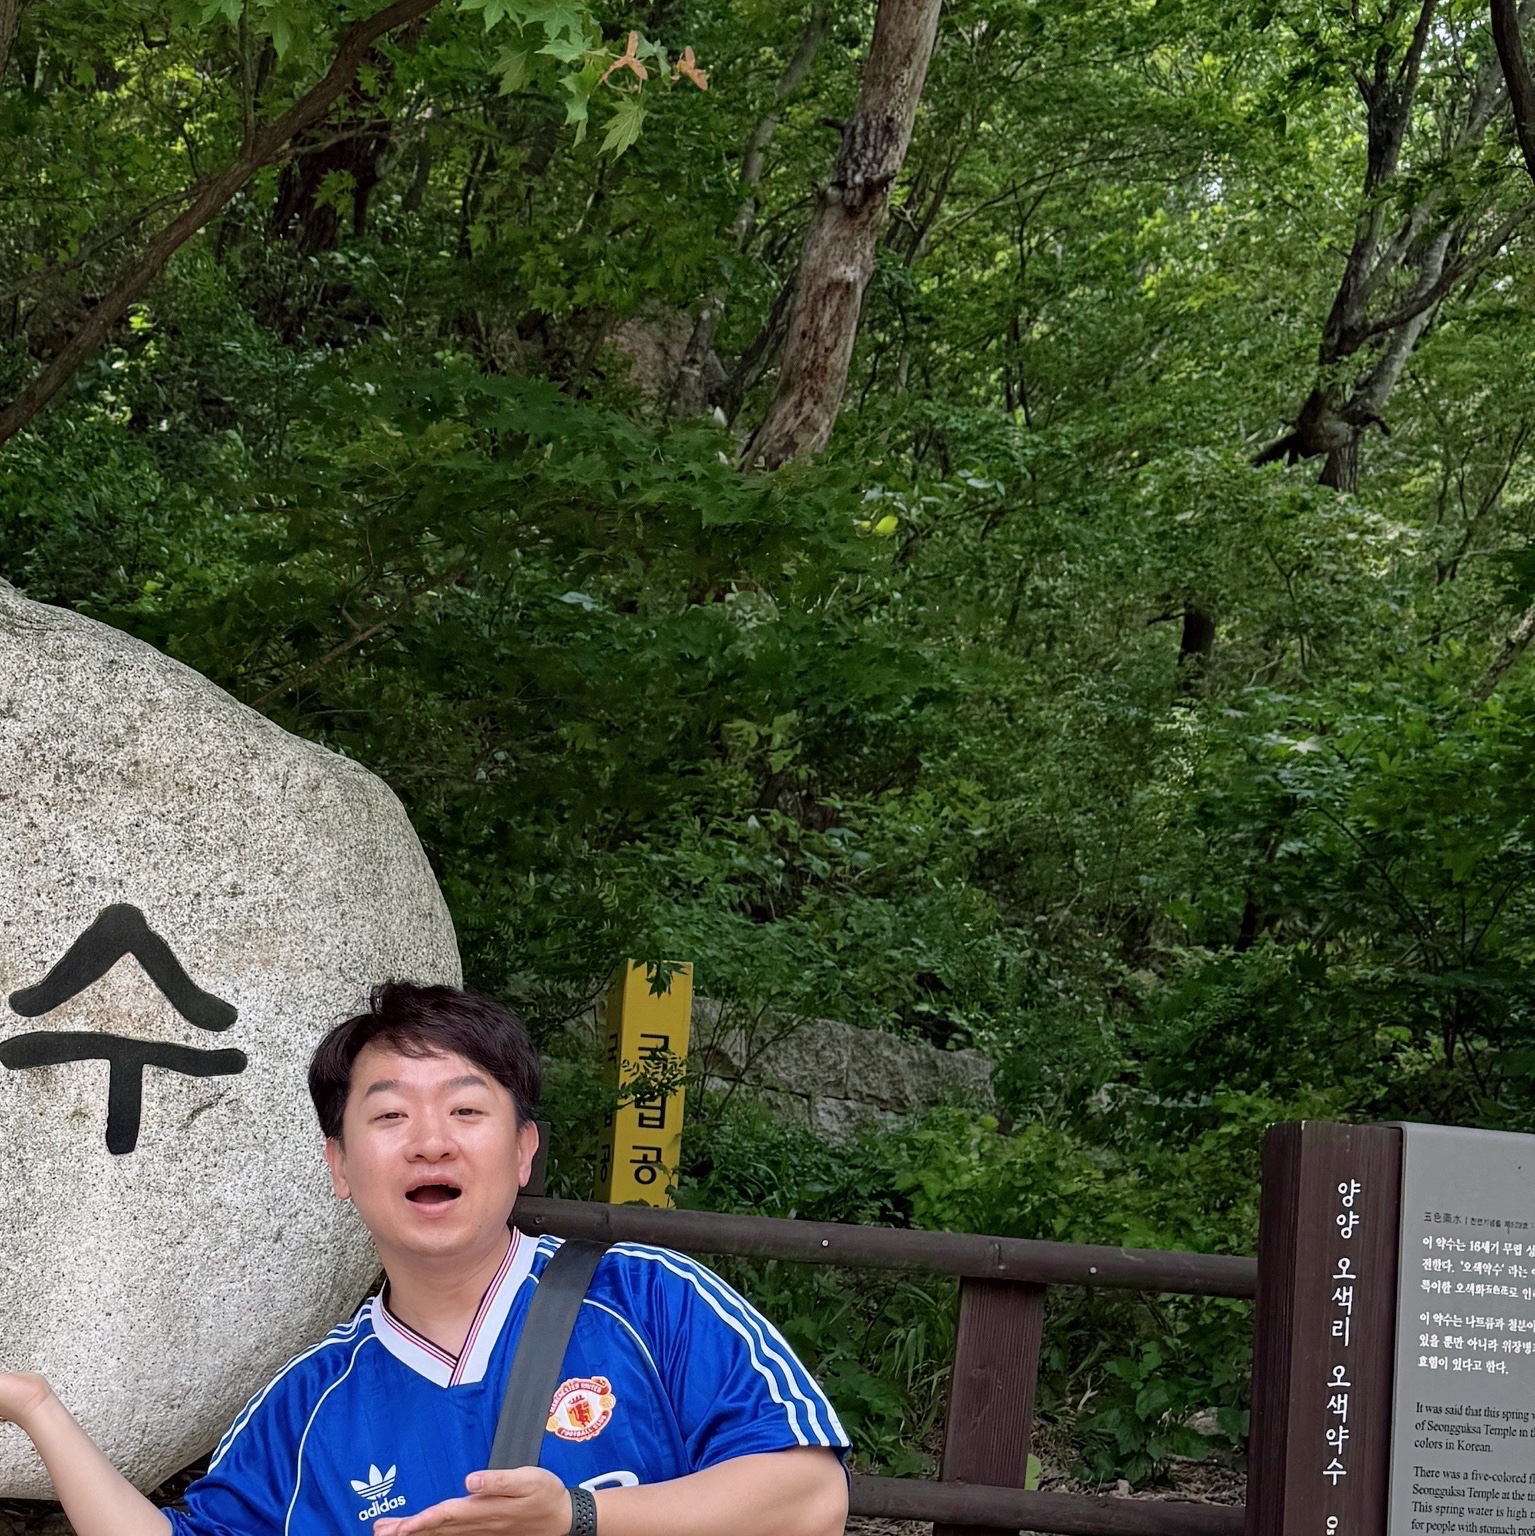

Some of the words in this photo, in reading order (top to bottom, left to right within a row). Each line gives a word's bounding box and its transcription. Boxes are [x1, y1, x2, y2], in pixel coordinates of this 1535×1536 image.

[1336, 1178, 1361, 1239] 양양
[1422, 1235, 1433, 1250] 이
[1435, 1236, 1466, 1252] 약수는
[1469, 1240, 1500, 1255] 16세기
[1502, 1242, 1522, 1256] 무렵
[1421, 1257, 1455, 1273] 전한다.
[1420, 1279, 1452, 1294] 특이한
[1521, 1286, 1535, 1301] 인
[1331, 1257, 1357, 1347] 오색리
[1419, 1311, 1430, 1326] 이
[1432, 1312, 1463, 1328] 약수는
[1465, 1314, 1505, 1331] 나트륨과
[1419, 1333, 1440, 1348] 있을
[1442, 1335, 1464, 1349] 뿐만
[1466, 1337, 1498, 1352] 아니라
[1452, 1357, 1482, 1372] 있다고
[1485, 1359, 1509, 1375] 한다.
[1416, 1401, 1423, 1413] It
[1425, 1405, 1443, 1415] was
[1444, 1404, 1463, 1416] said
[1465, 1405, 1482, 1417] that
[1484, 1406, 1500, 1418] this
[1502, 1408, 1530, 1423] spring
[1322, 1364, 1352, 1486] 오색약수
[1414, 1419, 1426, 1431] of
[1427, 1420, 1482, 1436] Seongguksa
[1483, 1424, 1517, 1439] Temple
[1519, 1428, 1528, 1438] in
[1414, 1437, 1443, 1449] colors
[1445, 1438, 1455, 1451] in
[1457, 1439, 1493, 1453] Korean.
[1413, 1465, 1440, 1478] There
[1443, 1470, 1461, 1480] was
[1463, 1471, 1469, 1480] a
[1471, 1469, 1527, 1484] five-colored
[1412, 1483, 1465, 1499] Seongguksa
[1467, 1486, 1500, 1502] Temple
[1501, 1491, 1510, 1500] at
[1512, 1489, 1525, 1501] the
[358, 1494, 406, 1522] adidas
[1412, 1501, 1433, 1513] This
[1435, 1504, 1465, 1518] spring
[1467, 1506, 1494, 1517] water
[1496, 1505, 1504, 1517] is
[1506, 1507, 1527, 1521] high
[1411, 1518, 1425, 1530] for
[1426, 1520, 1456, 1534] people
[1457, 1521, 1478, 1533] with
[1479, 1524, 1516, 1535] stomach
